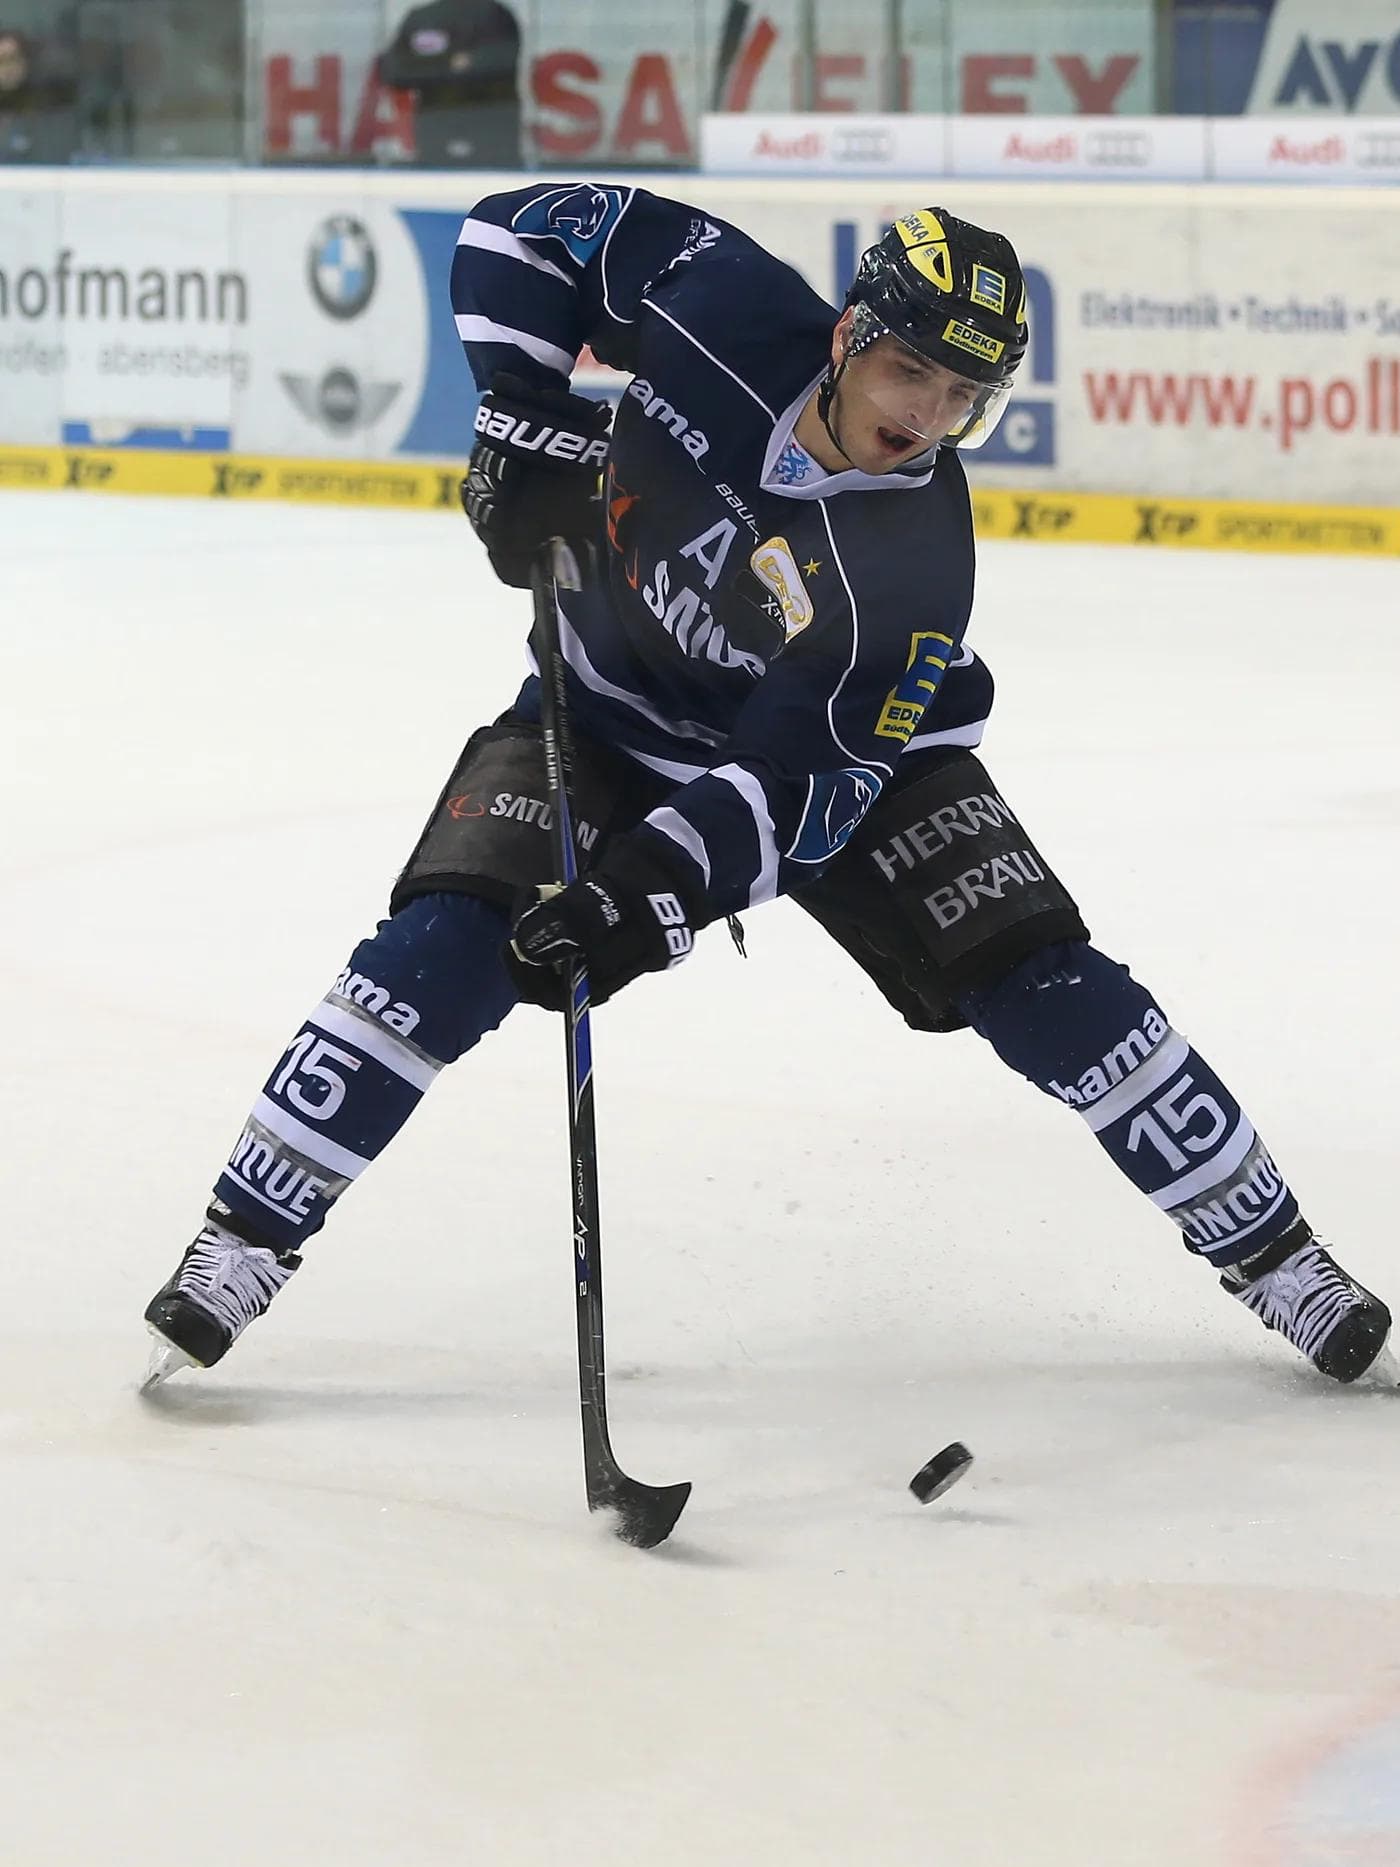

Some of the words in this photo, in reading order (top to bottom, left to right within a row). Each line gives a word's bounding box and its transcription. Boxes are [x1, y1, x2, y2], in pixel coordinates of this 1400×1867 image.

[267, 53, 690, 155] HASA
[755, 131, 824, 158] Audi
[1004, 132, 1076, 162] Audi
[1269, 134, 1346, 164] Audi
[951, 324, 998, 353] EDEKA
[1081, 293, 1220, 329] Elektronik
[1246, 297, 1348, 333] Technik
[678, 517, 738, 590] A
[489, 791, 601, 852] SATUN
[923, 845, 1046, 931] BRÄU
[270, 1031, 363, 1121] 15
[1126, 1073, 1228, 1172] 15
